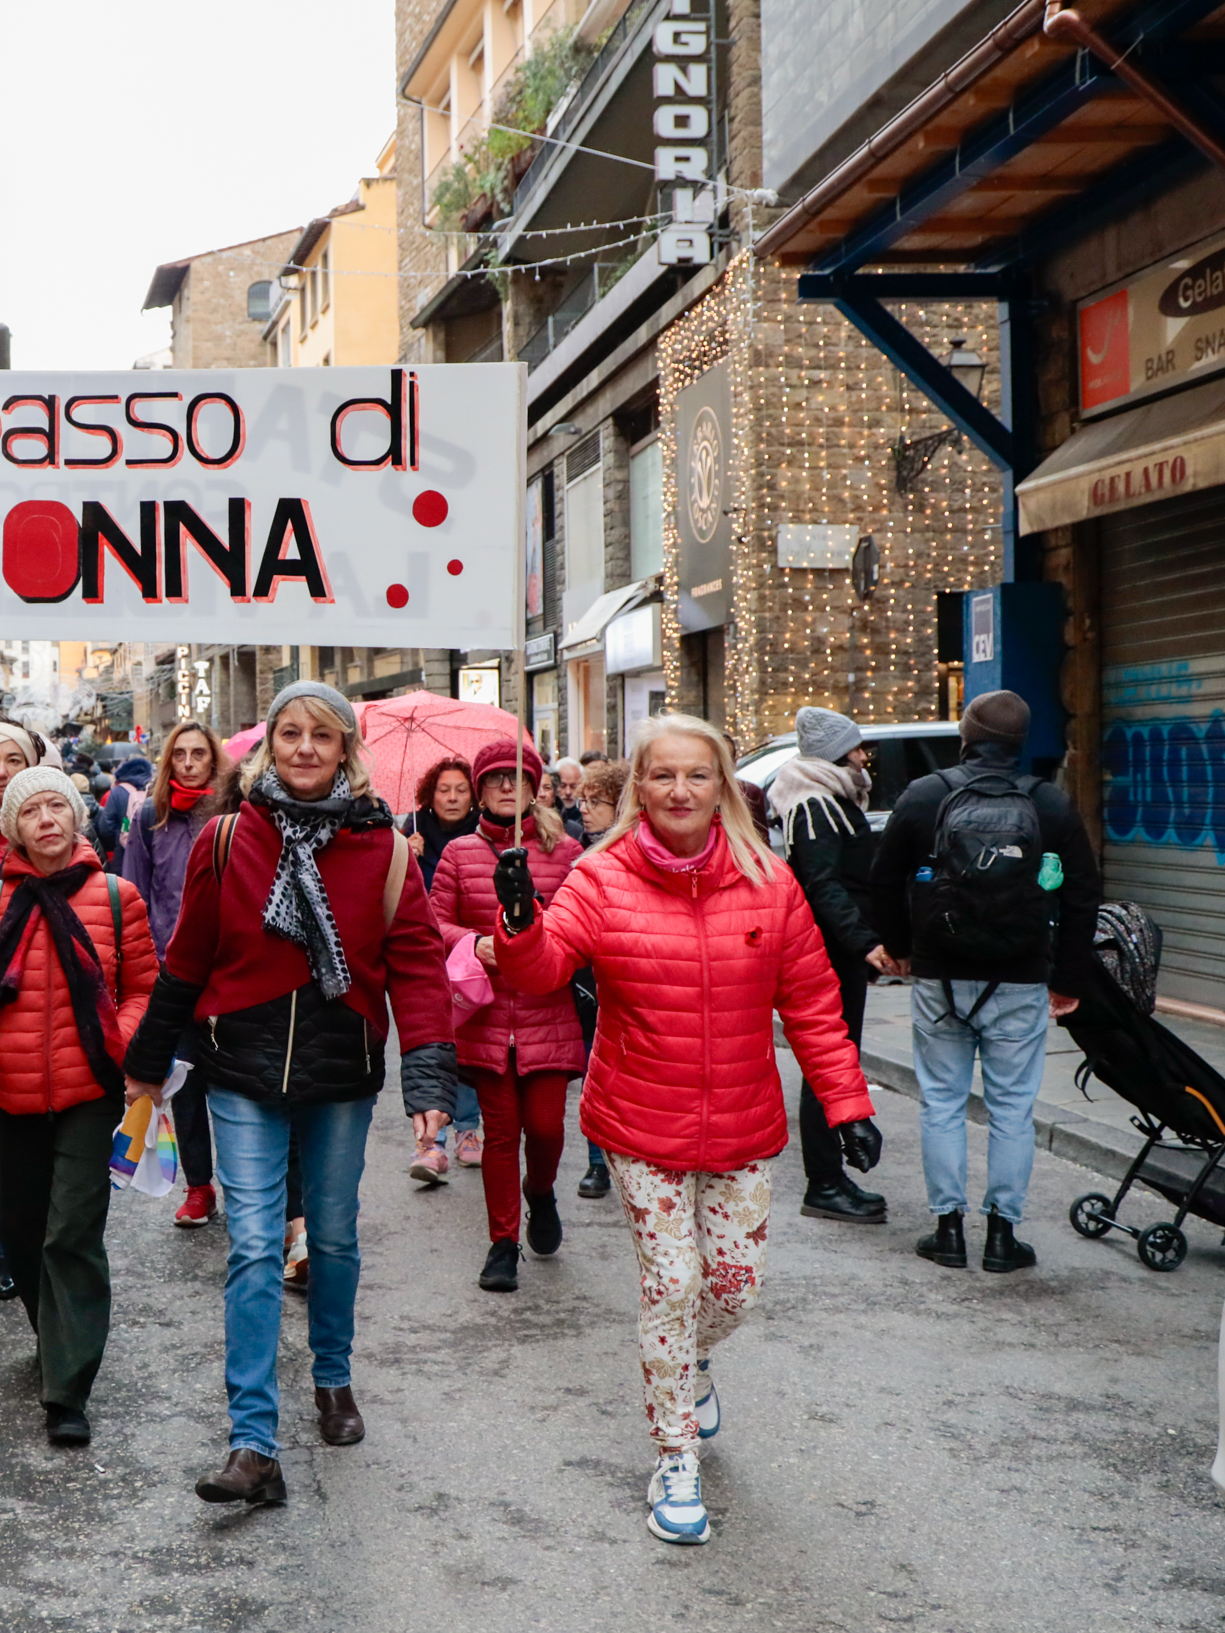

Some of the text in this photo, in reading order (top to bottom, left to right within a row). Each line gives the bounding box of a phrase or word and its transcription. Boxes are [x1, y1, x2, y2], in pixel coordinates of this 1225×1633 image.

[1145, 349, 1176, 381] BAR
[329, 368, 420, 472] di
[1092, 454, 1188, 507] GELATO
[194, 661, 211, 713] TAF
